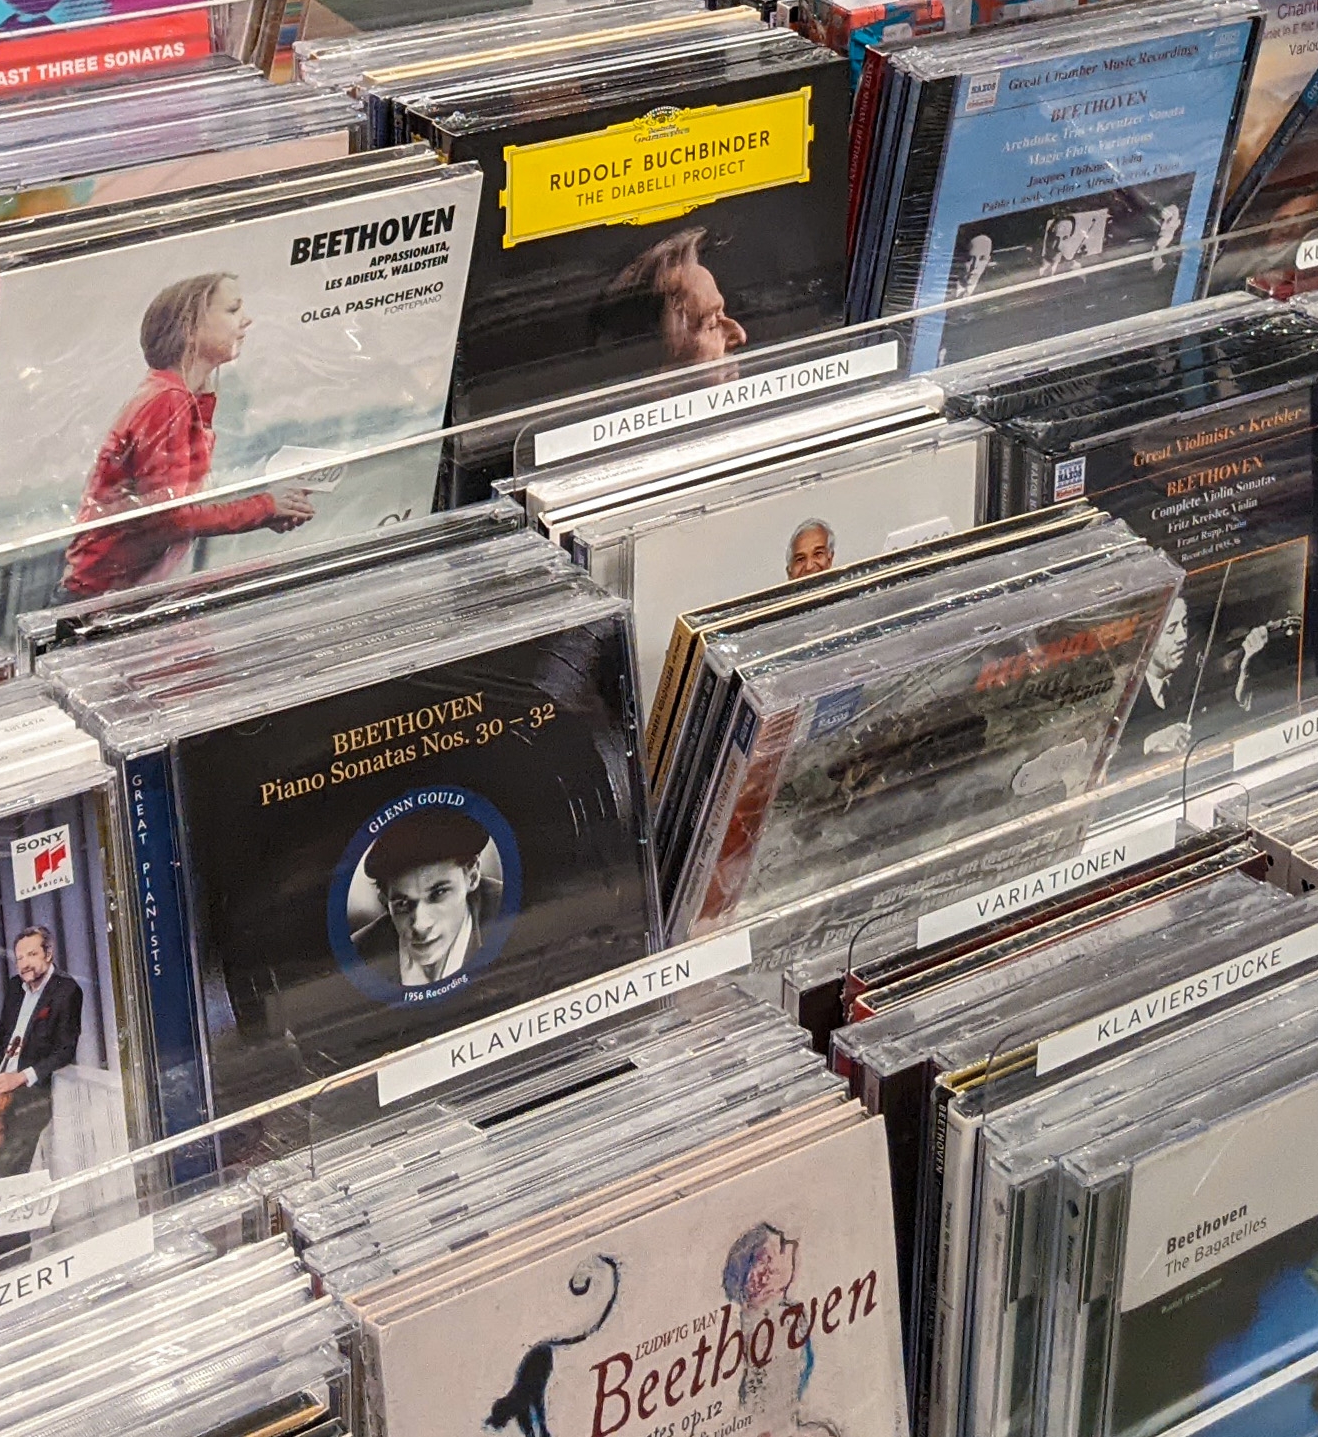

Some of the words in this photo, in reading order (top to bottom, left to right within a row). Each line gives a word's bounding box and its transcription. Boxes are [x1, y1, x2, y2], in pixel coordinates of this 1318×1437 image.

[36, 62, 100, 81] THREE
[104, 42, 186, 70] SONATAS
[1009, 75, 1041, 92] Great
[1045, 64, 1098, 82] Chamber
[1102, 57, 1133, 72] Music
[1139, 44, 1199, 65] Recordings
[1051, 90, 1148, 123] BEETHOVEN
[550, 158, 633, 191] RUDOLF
[643, 130, 771, 171] BUCHBINDER
[576, 191, 603, 206] THE
[611, 174, 677, 200] DIABELLI
[683, 160, 746, 182] PROJECT
[290, 205, 456, 266] BEETHOVEN
[325, 278, 341, 291] LES
[345, 269, 388, 289] ADIEUX,
[391, 255, 449, 278] WALDSTEIN
[300, 306, 341, 323] OLGA
[344, 281, 444, 314] PASHCHENKO
[384, 295, 442, 316] FORTEPIANO
[593, 400, 694, 442] DIABELLI
[706, 361, 850, 409] VARIATIONEN
[1151, 496, 1200, 521] Complete
[1205, 487, 1233, 503] Violin
[1236, 475, 1276, 493] Sonatas
[1167, 455, 1265, 497] BEETHOVEN
[332, 693, 485, 756] BEETHOVEN
[368, 797, 414, 835] GLENN
[417, 792, 466, 808] GOULD
[15, 831, 65, 854] SONY
[976, 846, 1126, 917] VARIATIONEN
[403, 990, 424, 1002] 1956
[426, 973, 469, 999] Recording
[1096, 949, 1281, 1041] KLAVIERSTÜCKE
[450, 961, 692, 1067] KLAVIERSONATEN
[1164, 1254, 1190, 1278] The
[1193, 1216, 1267, 1266] Bagatelles
[1165, 1204, 1249, 1255] Beethoven
[589, 1270, 878, 1437] Beethoven
